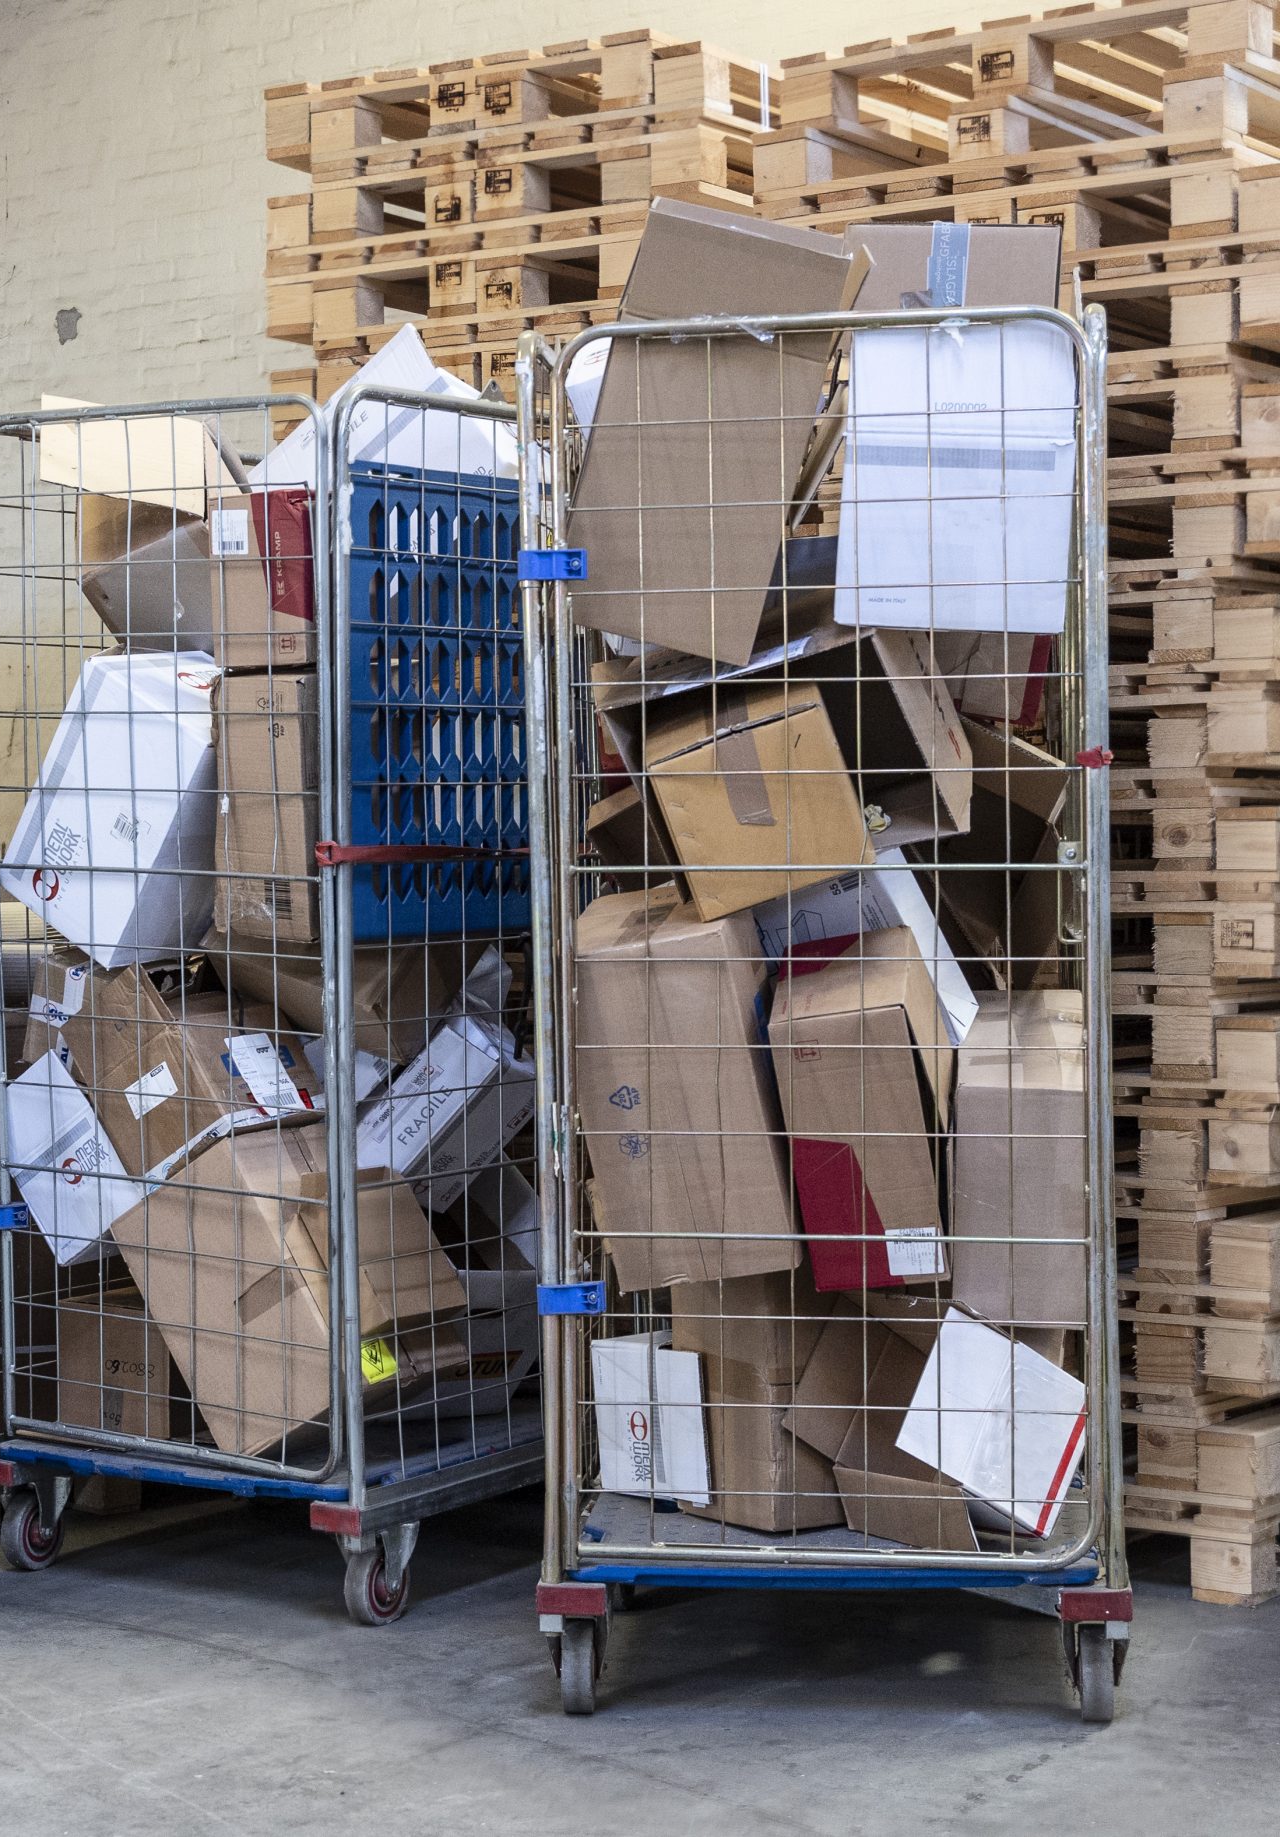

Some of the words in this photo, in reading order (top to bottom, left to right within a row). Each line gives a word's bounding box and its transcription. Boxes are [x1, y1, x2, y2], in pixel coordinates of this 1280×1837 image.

[275, 531, 284, 577] KRAMP
[43, 821, 68, 866] METAL
[56, 828, 81, 875] WORK
[829, 882, 843, 896] 55
[397, 1084, 453, 1146] FRAGILE
[630, 1087, 641, 1105] PAP
[75, 1136, 102, 1165] METAL
[82, 1145, 110, 1173] WORK
[632, 1442, 646, 1483] WORK
